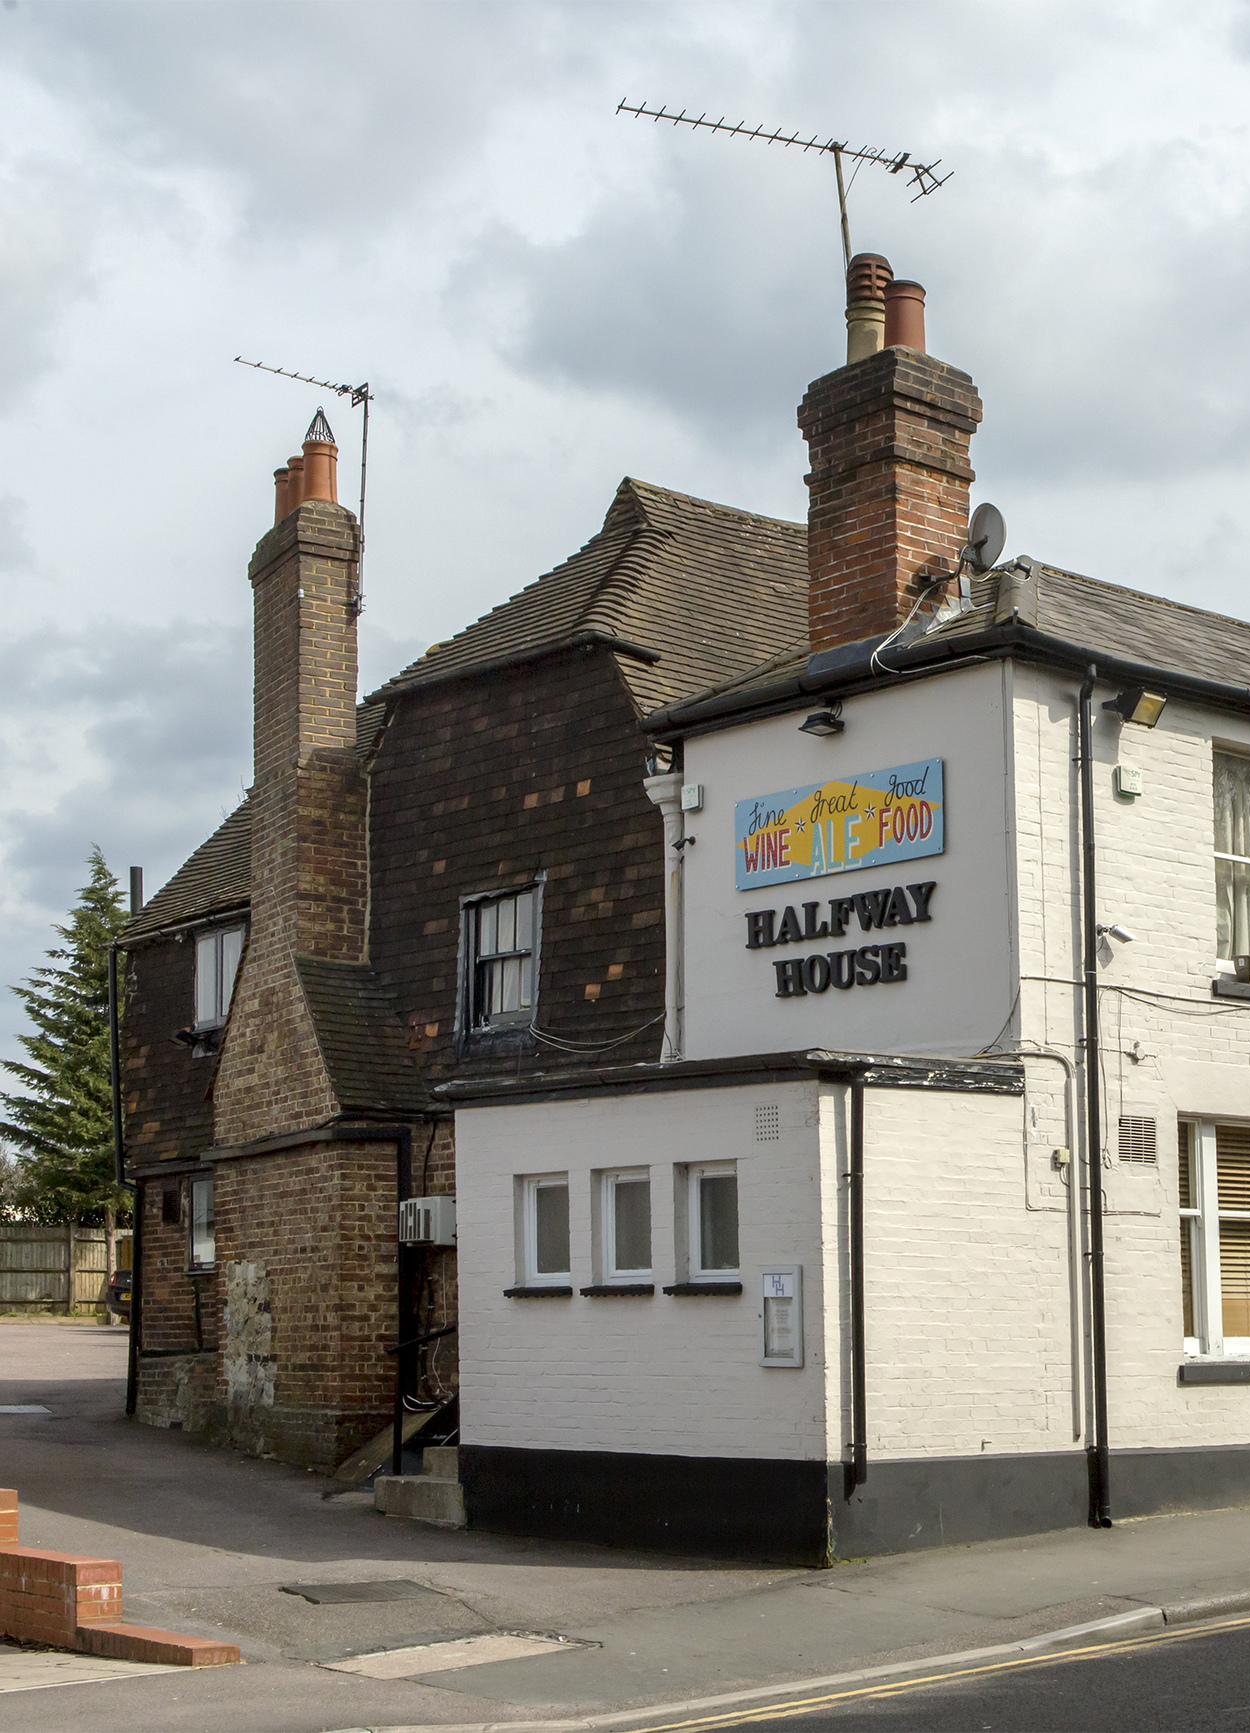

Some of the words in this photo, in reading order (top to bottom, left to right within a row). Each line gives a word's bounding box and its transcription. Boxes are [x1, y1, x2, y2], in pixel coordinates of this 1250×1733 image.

[810, 781, 858, 823] great
[884, 766, 929, 807] good
[743, 829, 791, 874] WINE
[810, 814, 862, 876] ALE
[878, 800, 934, 849] FOOD
[745, 881, 937, 949] HALFWAY
[772, 942, 907, 998] HOUSE
